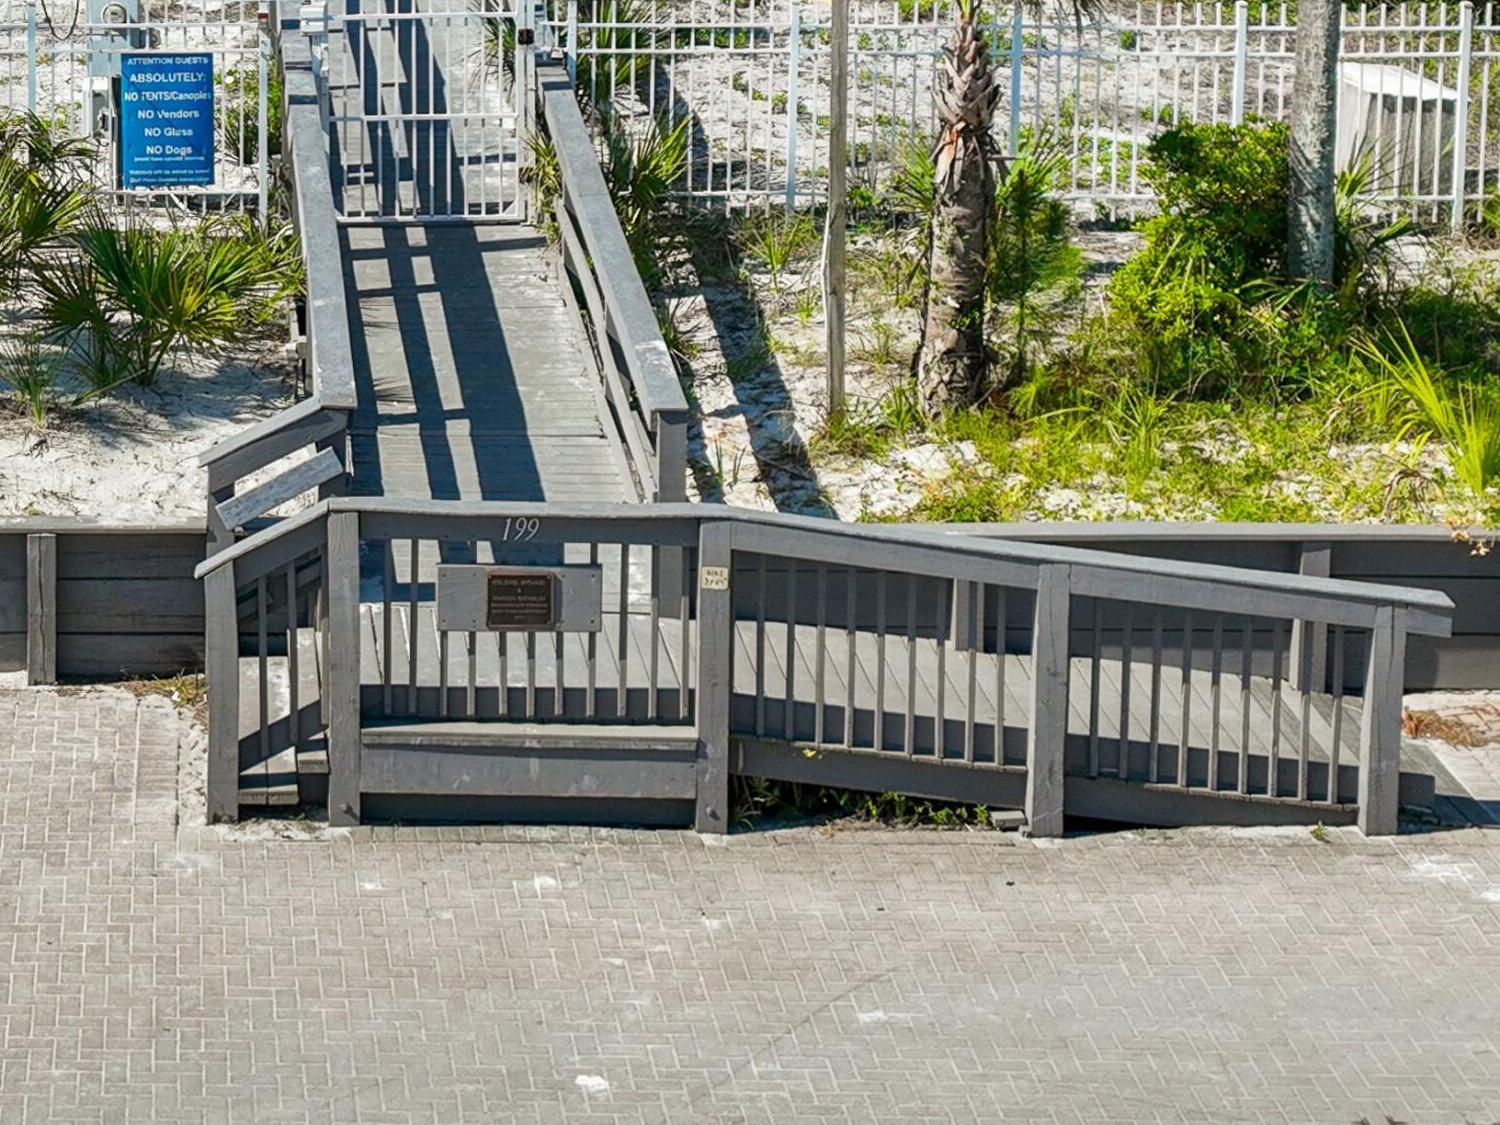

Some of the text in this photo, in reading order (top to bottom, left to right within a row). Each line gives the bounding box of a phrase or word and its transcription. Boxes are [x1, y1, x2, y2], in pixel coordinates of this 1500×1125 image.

[127, 56, 209, 65] ATTENTION GUESTS
[130, 72, 206, 83] ABSOLUTELY:
[124, 92, 138, 101] NO
[137, 109, 200, 119] NO Vendors
[144, 126, 193, 137] NO Glass
[146, 145, 193, 156] NO Dogs
[502, 516, 540, 542] 199
